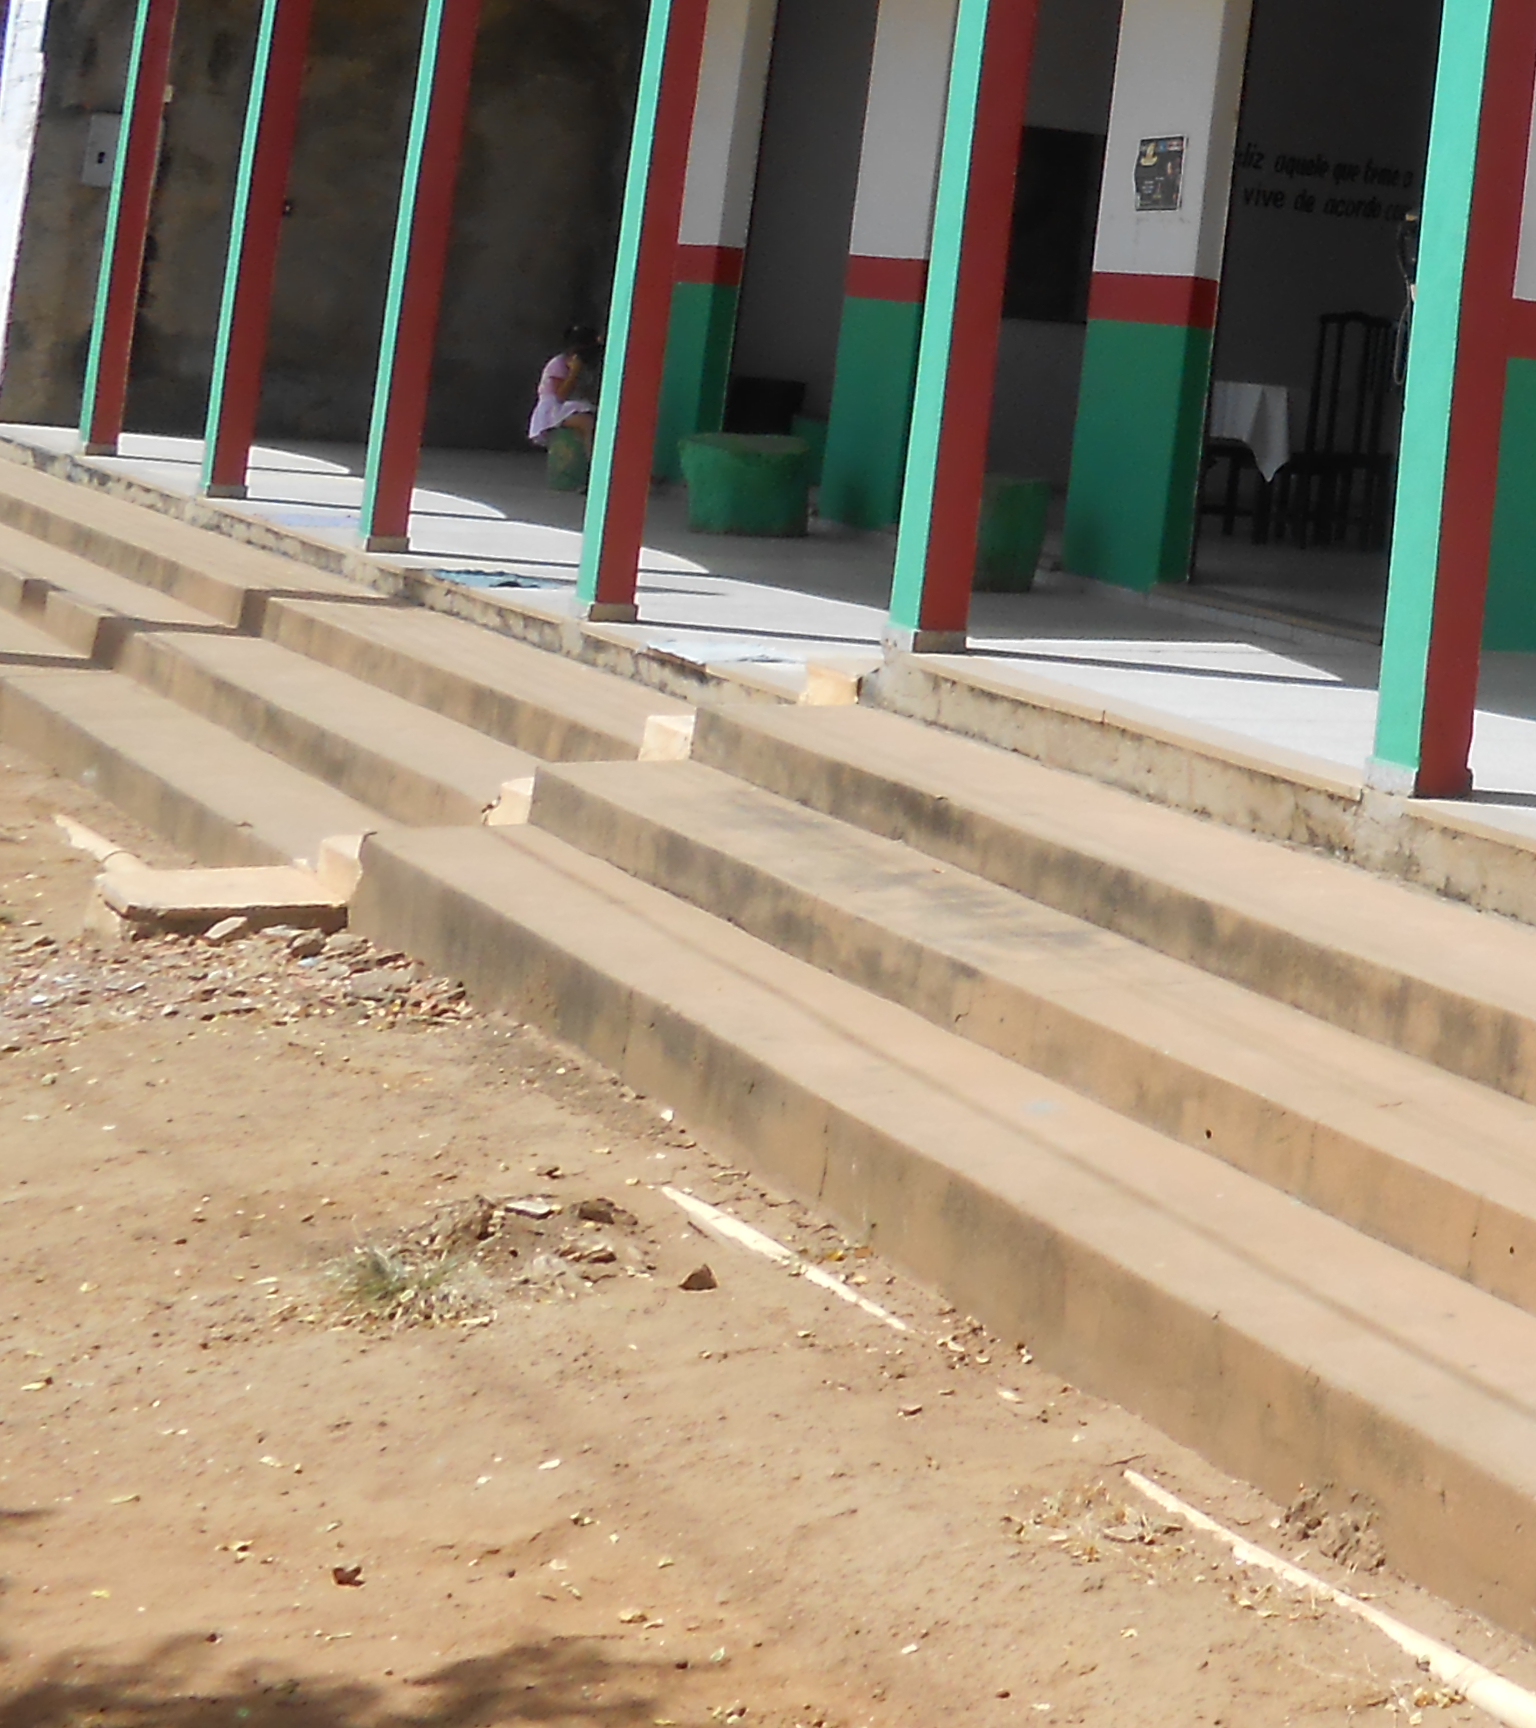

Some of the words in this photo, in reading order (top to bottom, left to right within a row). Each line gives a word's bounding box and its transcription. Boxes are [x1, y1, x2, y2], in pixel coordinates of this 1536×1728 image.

[1235, 142, 1264, 170] eliz
[1244, 186, 1285, 209] vive
[1293, 188, 1316, 213] de
[1322, 196, 1382, 219] acordo
